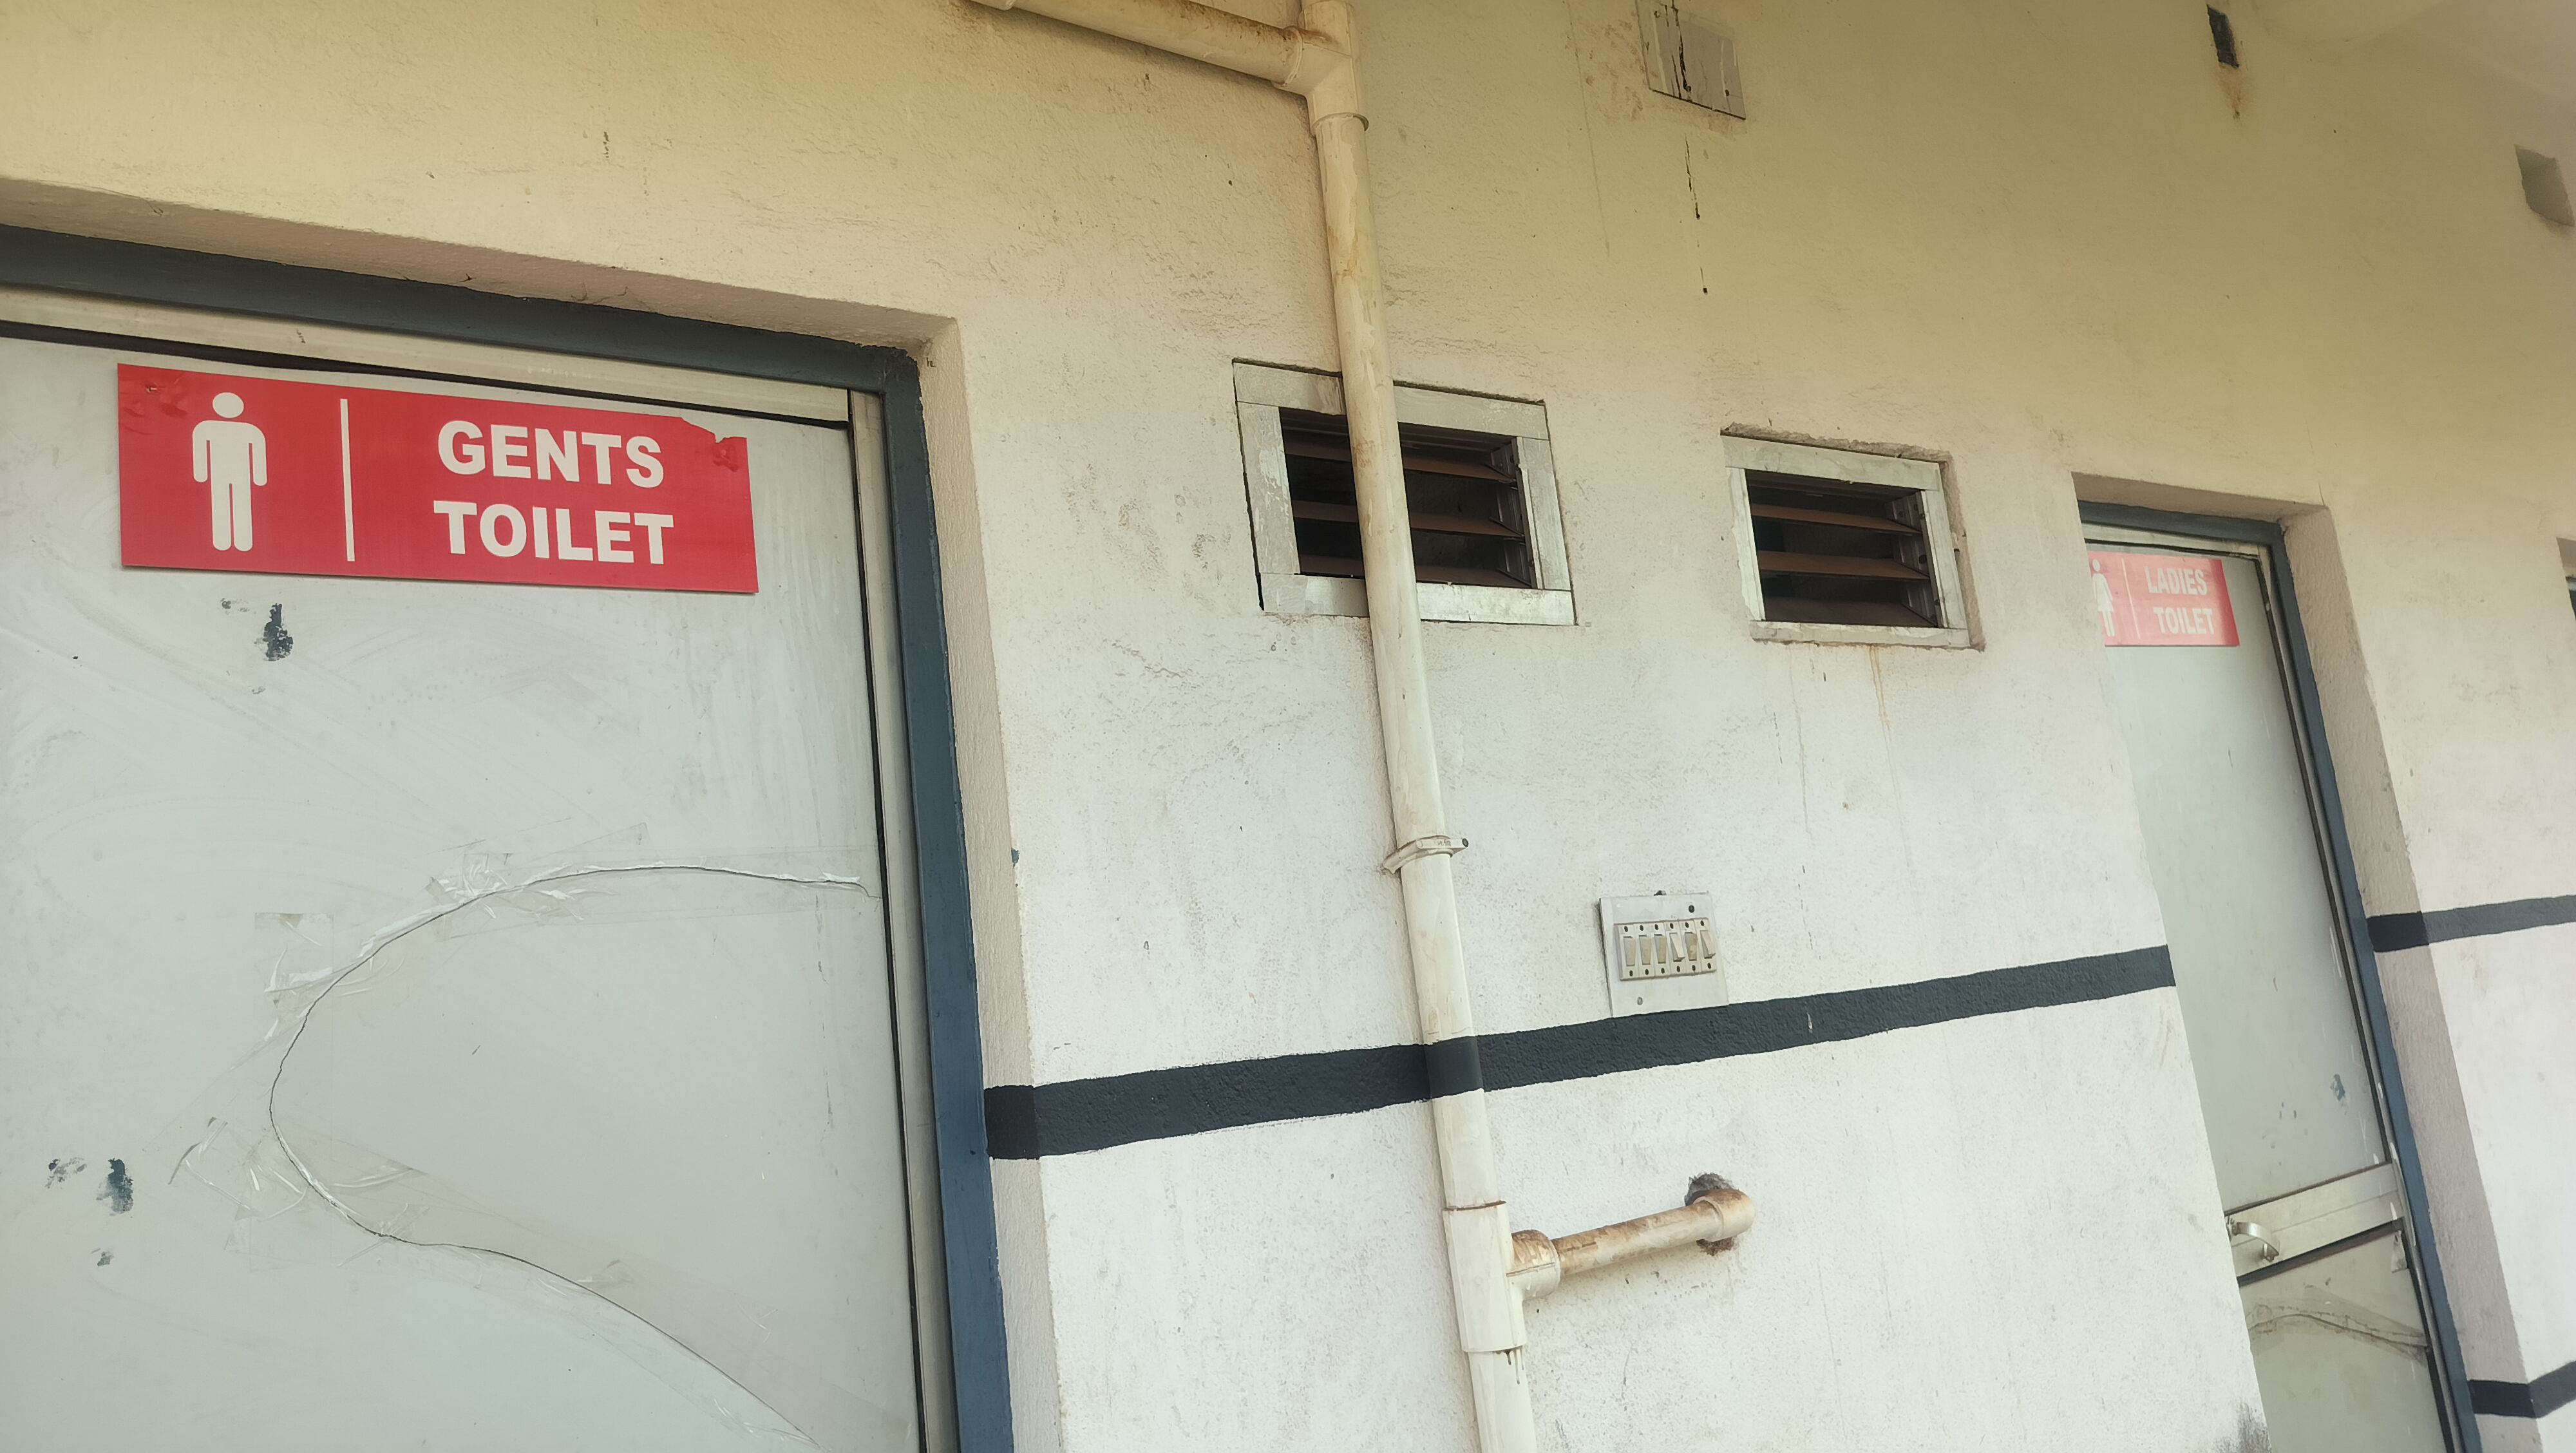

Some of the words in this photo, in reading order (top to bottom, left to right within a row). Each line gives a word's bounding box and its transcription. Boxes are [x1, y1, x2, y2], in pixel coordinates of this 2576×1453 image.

[438, 420, 664, 488] GENTS
[433, 500, 674, 565] TOILET
[2145, 566, 2208, 596] LADIES
[2153, 607, 2213, 634] TOILET
